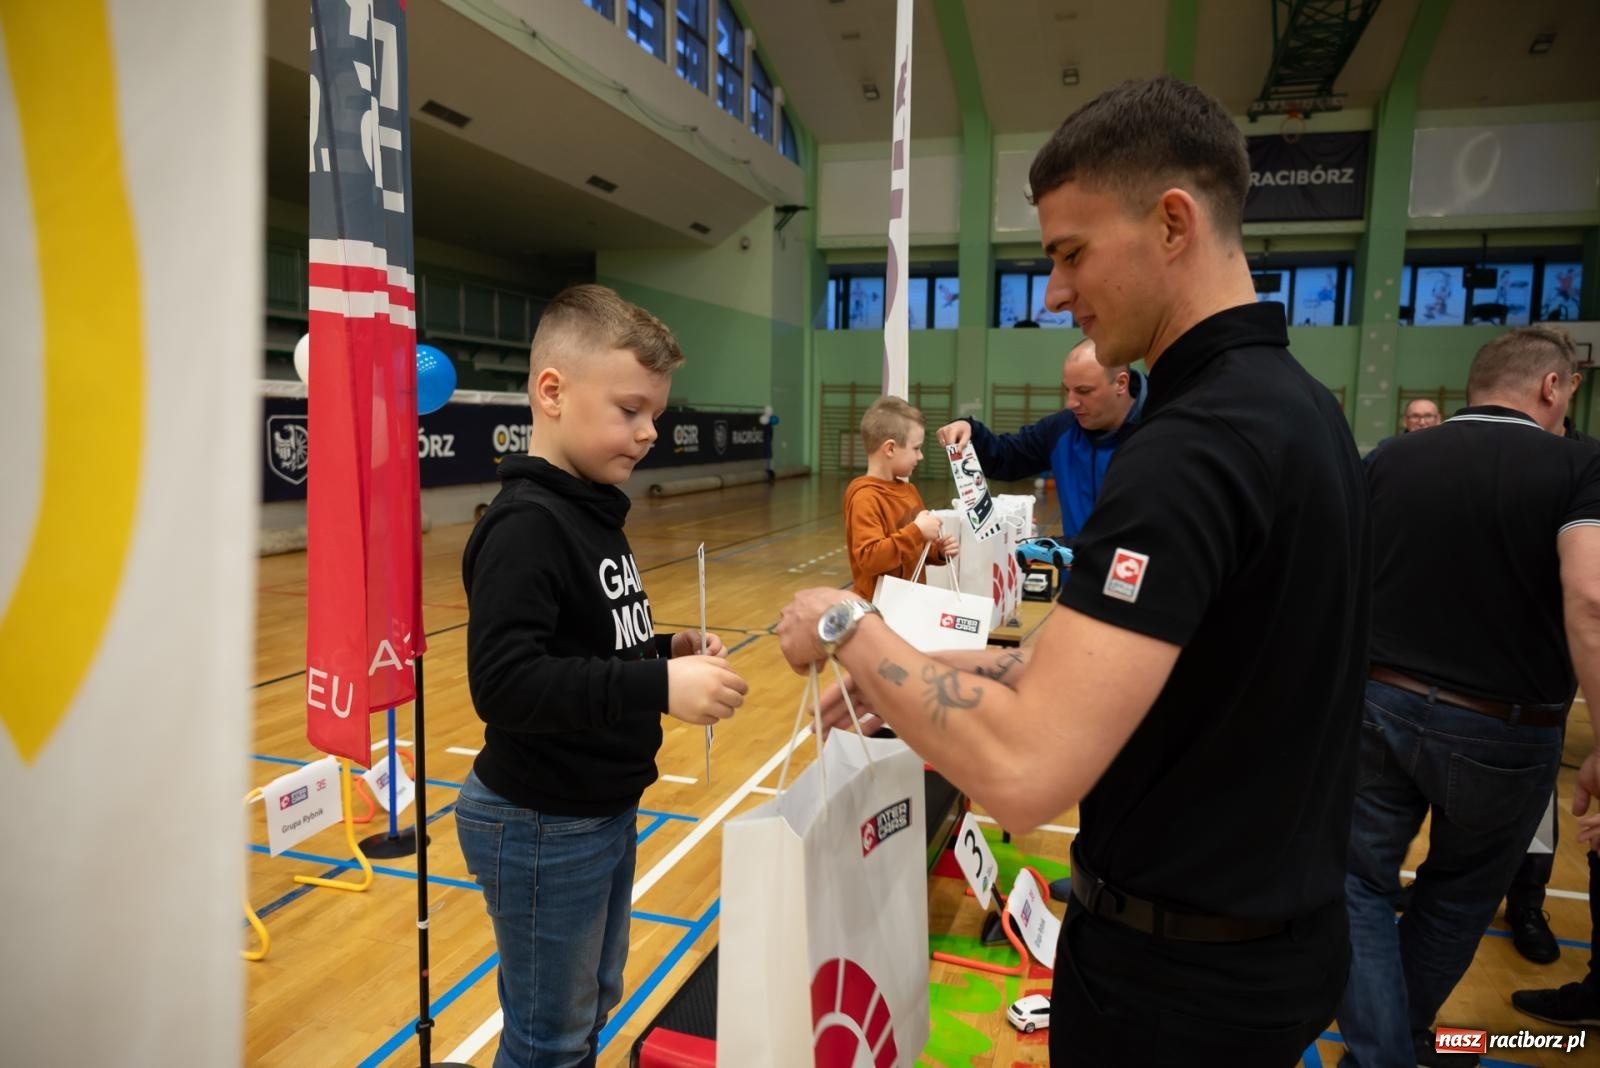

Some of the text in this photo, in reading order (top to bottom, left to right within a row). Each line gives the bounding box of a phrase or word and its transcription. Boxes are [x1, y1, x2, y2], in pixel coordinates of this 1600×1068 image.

[1249, 165, 1355, 187] RACIBÓRZ
[599, 554, 642, 600] GA
[878, 802, 908, 827] INTER
[878, 816, 908, 841] CARS
[965, 829, 983, 878] 3
